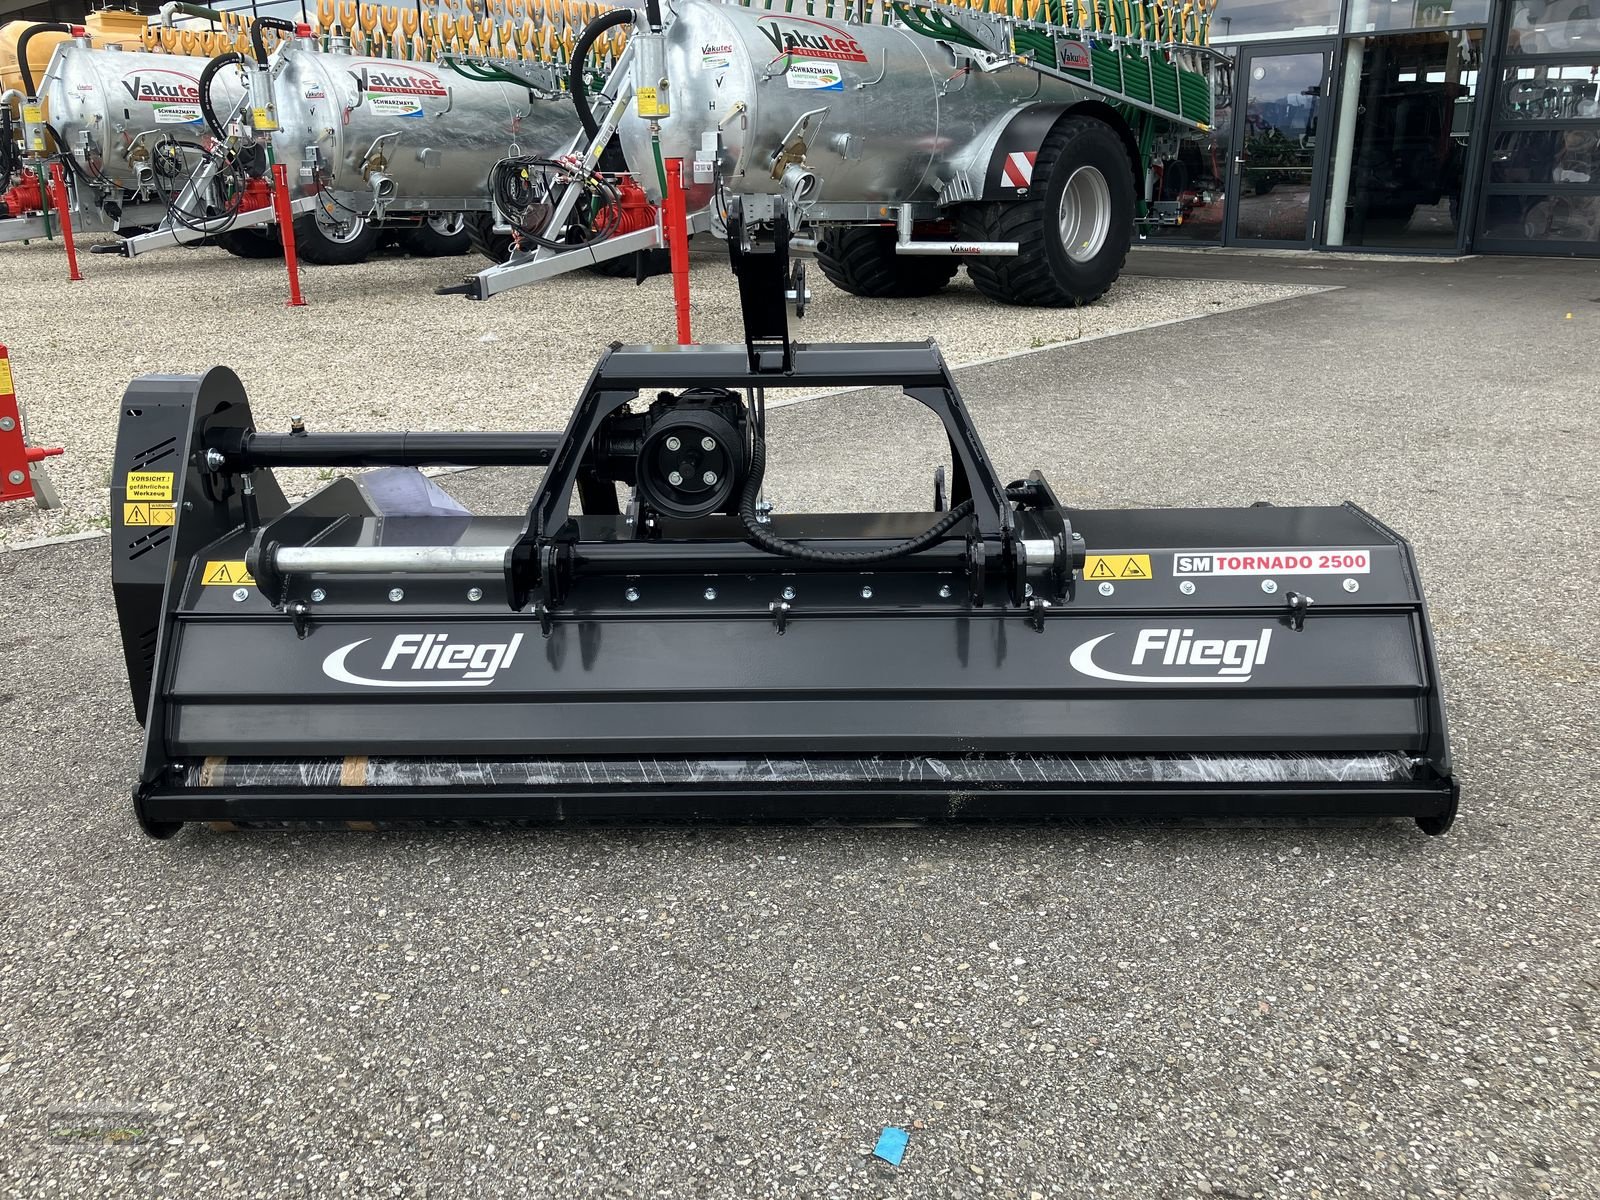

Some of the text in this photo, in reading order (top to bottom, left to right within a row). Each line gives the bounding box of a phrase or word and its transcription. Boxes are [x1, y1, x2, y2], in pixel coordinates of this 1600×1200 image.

[757, 22, 863, 54] Vakutec
[701, 44, 732, 55] Vakutec
[347, 67, 445, 91] Vakutec
[789, 65, 834, 74] SCHWARZMAYR
[121, 77, 200, 100] Vakute
[708, 100, 716, 111] H
[950, 244, 980, 253] Vakutec
[1178, 555, 1367, 572] SM TORNADO 2500
[380, 632, 525, 678] Fliegl
[1131, 628, 1273, 675] Fliegl
